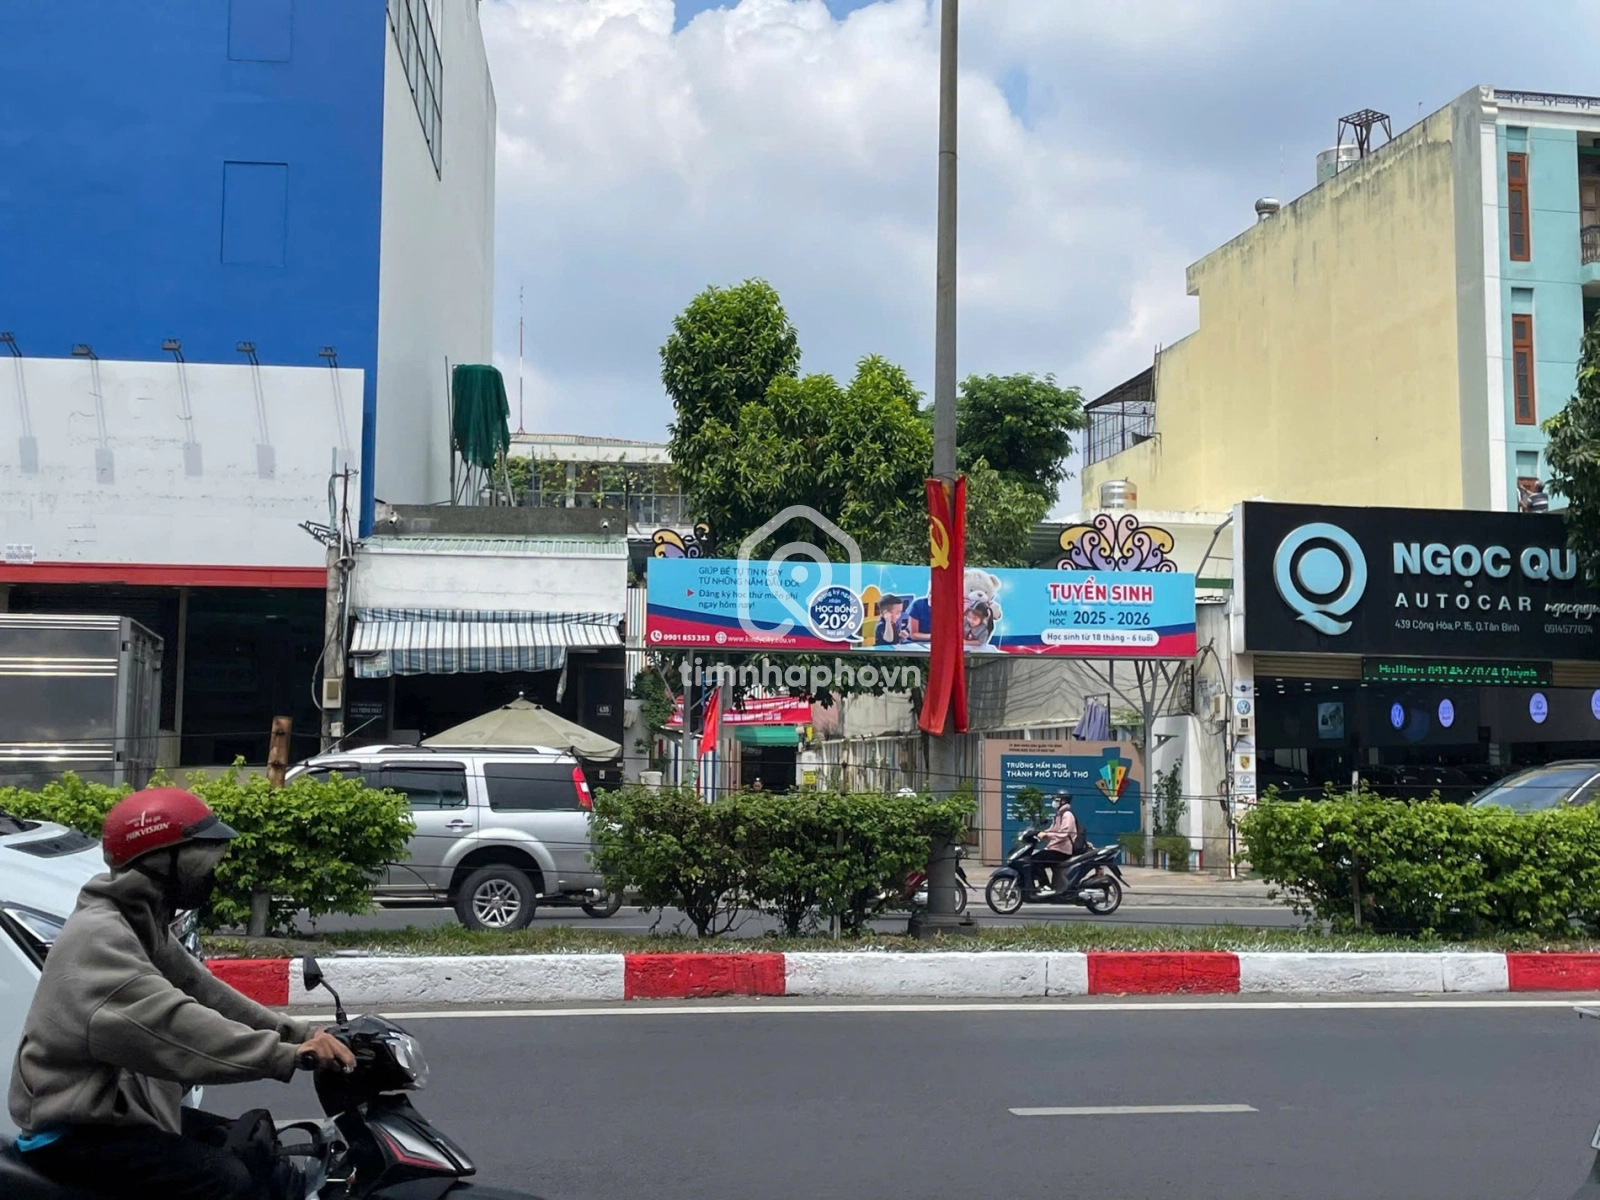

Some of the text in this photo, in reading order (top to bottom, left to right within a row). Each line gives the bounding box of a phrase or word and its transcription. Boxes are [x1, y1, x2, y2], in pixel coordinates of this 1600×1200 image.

[1393, 542, 1578, 588] NGỌC QU
[761, 568, 783, 577] NGAY
[1050, 576, 1153, 602] TUYỂN SINH
[699, 601, 718, 610] ngay
[719, 600, 737, 609] hôm
[815, 605, 834, 615] HỌC
[1049, 608, 1067, 617] NĂM
[818, 613, 856, 630] 20%
[1049, 618, 1066, 626] HỌC
[1073, 610, 1106, 625] 2025
[1117, 611, 1151, 626] 2026
[1394, 619, 1411, 629] 439
[1412, 619, 1435, 632] Cộng
[1047, 633, 1062, 642] Học
[1063, 633, 1080, 641] sinh
[1093, 633, 1102, 641] 18
[1103, 633, 1125, 643] tháng
[1006, 769, 1033, 778] THÀNH
